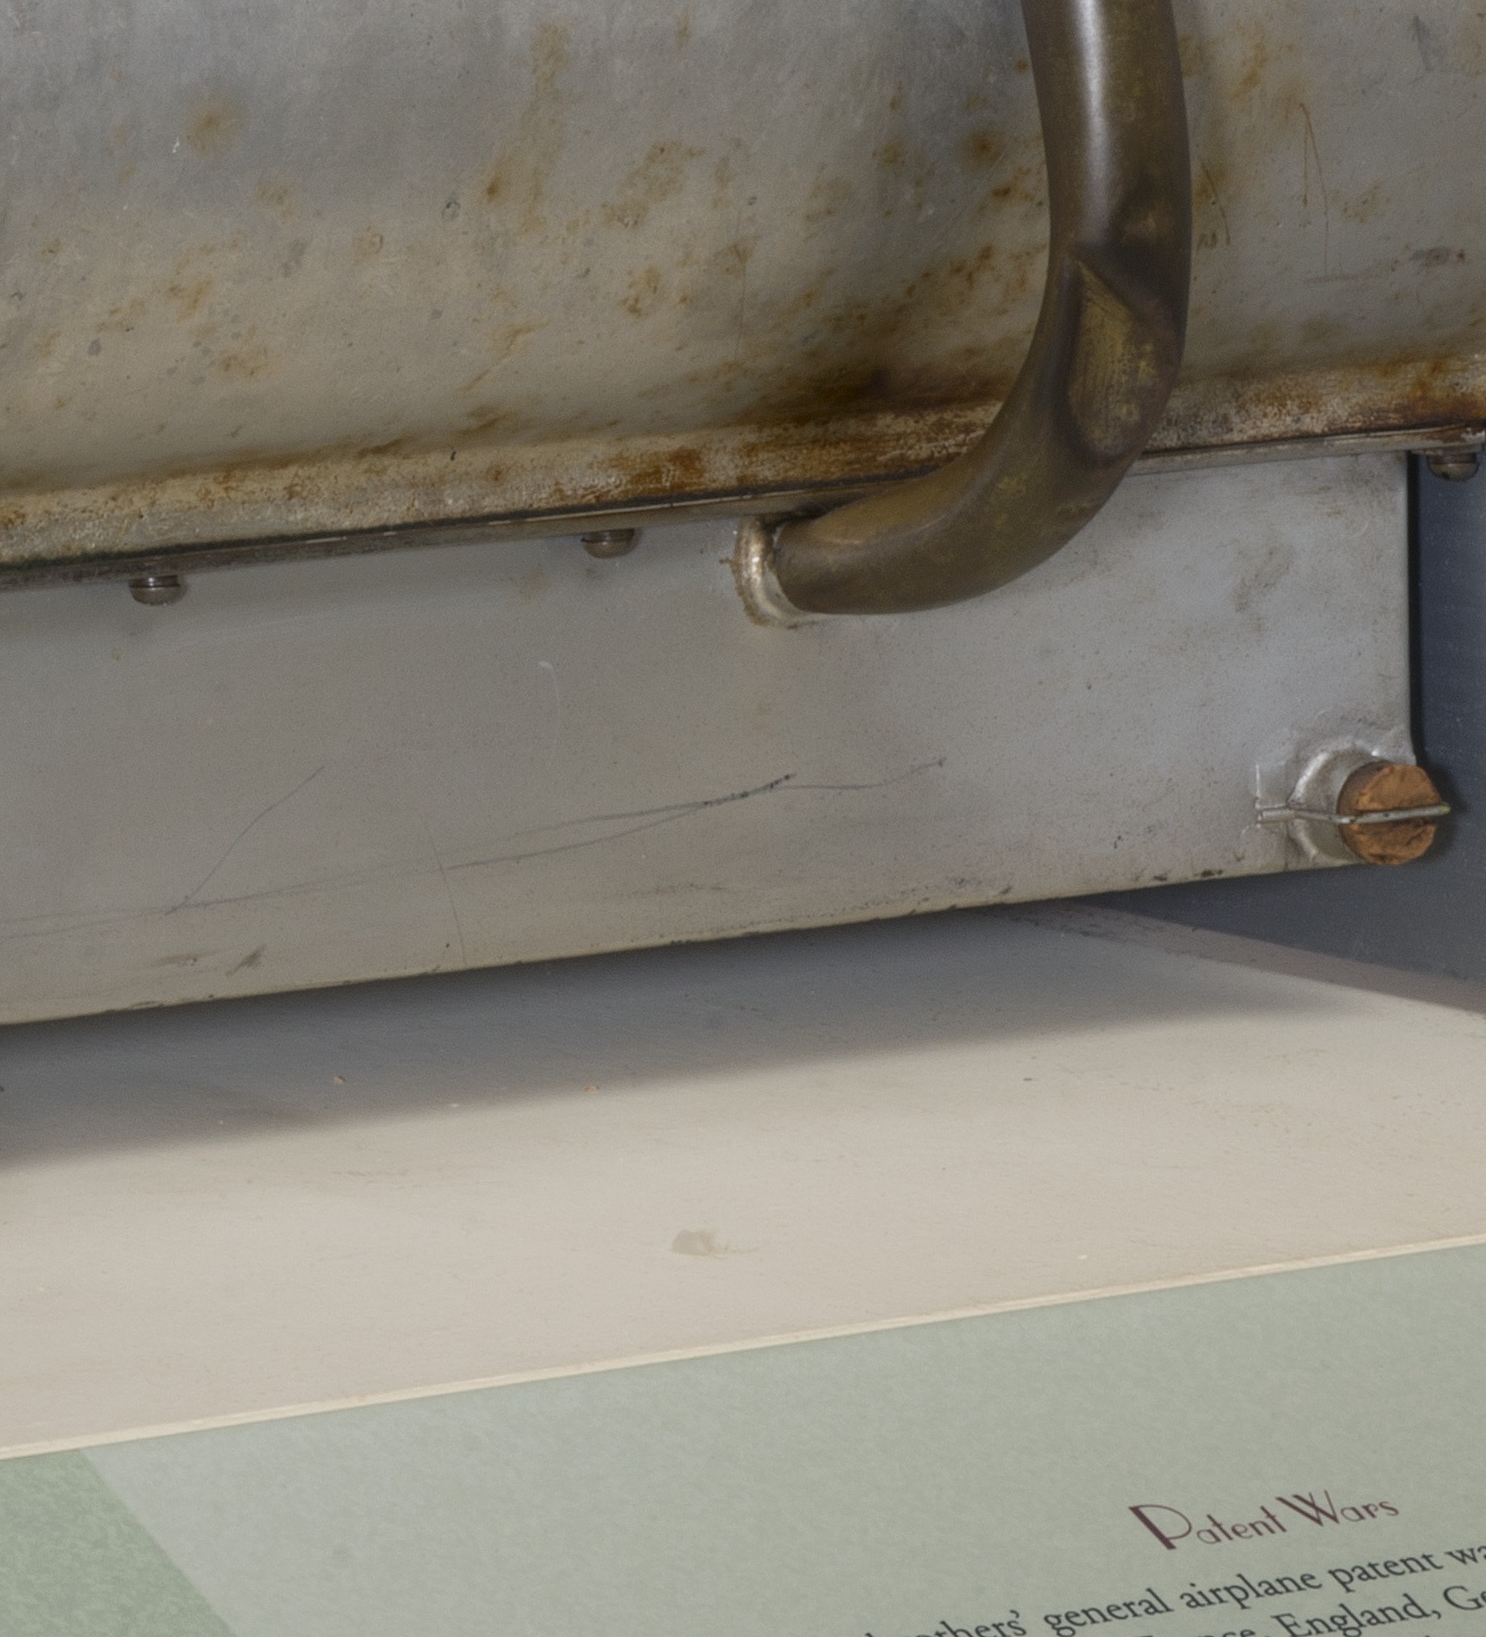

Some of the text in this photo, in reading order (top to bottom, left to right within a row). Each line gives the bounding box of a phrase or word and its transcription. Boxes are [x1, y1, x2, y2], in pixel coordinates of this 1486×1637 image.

[1129, 1490, 1399, 1550] Patent Wars
[1044, 1588, 1174, 1637] general
[1180, 1574, 1322, 1610] airplane
[1328, 1554, 1443, 1593] patent
[1271, 1593, 1441, 1637] England,
